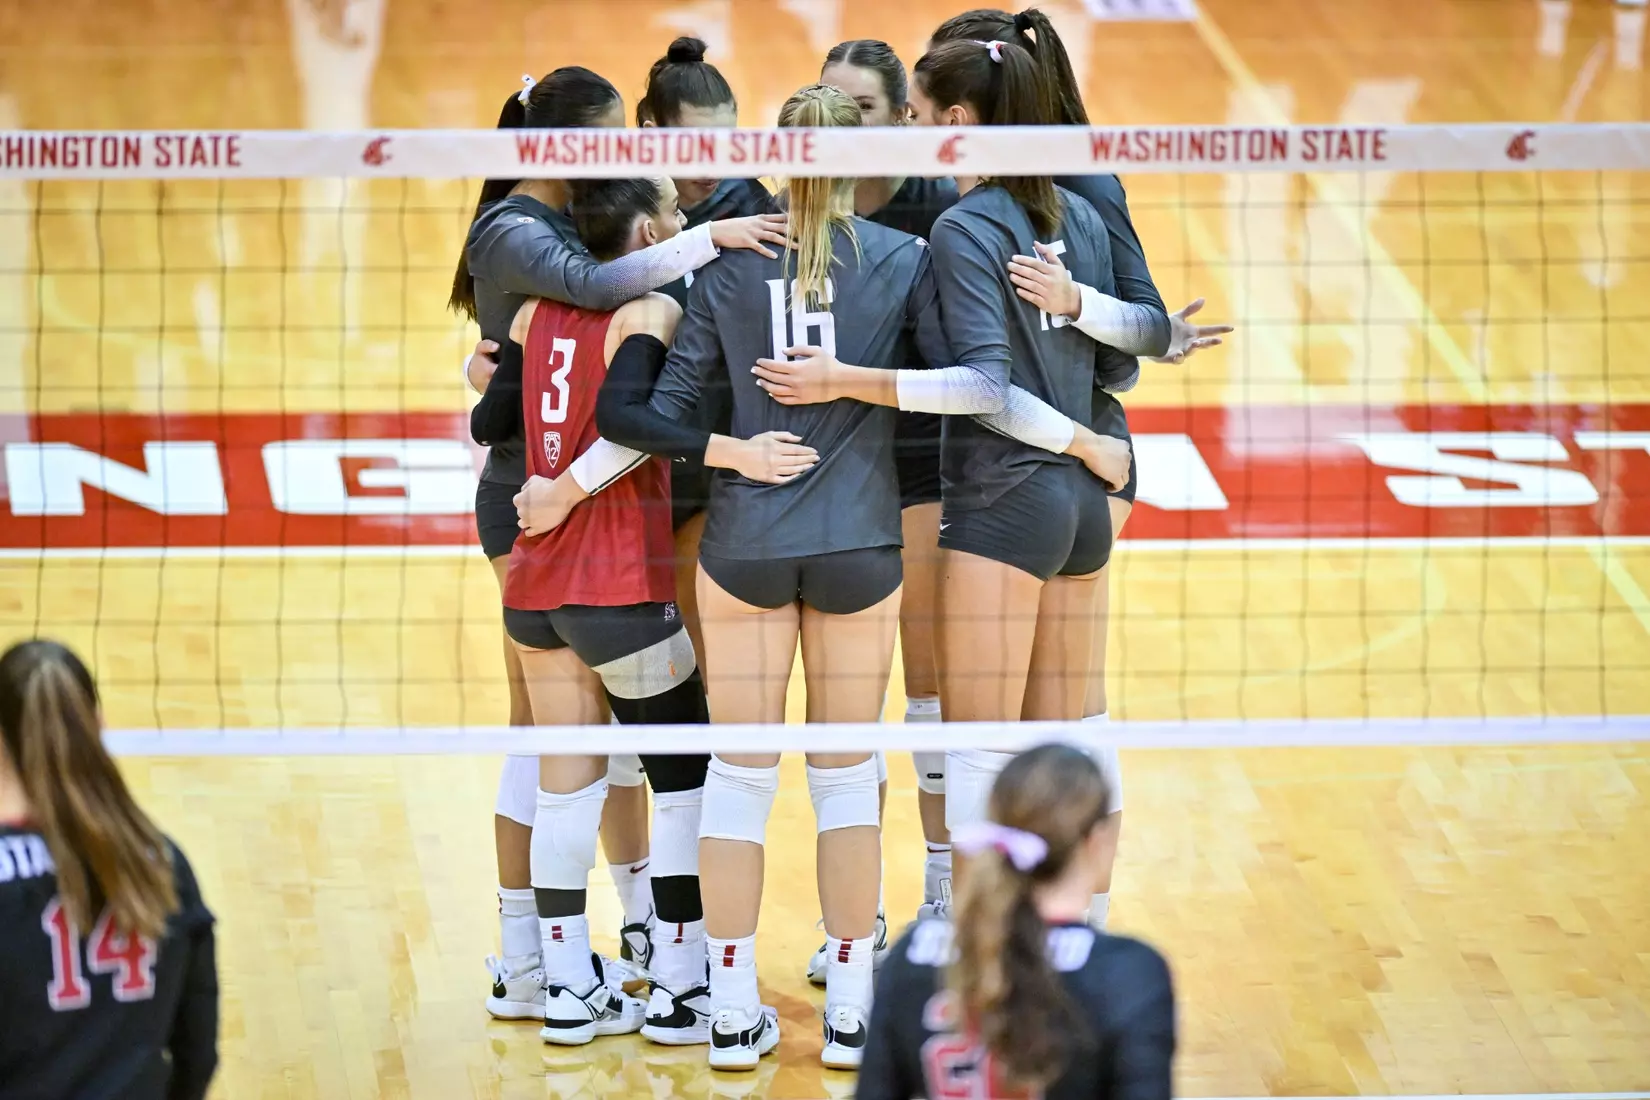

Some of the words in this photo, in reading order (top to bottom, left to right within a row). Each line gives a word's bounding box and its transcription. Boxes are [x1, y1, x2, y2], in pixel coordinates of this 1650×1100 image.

[0, 135, 141, 169] HINGTON
[154, 134, 242, 168] STATE
[515, 132, 716, 166] WASHINGTON
[729, 132, 817, 165] STATE
[1088, 130, 1288, 163] WASHINGTON
[1301, 128, 1388, 162] STATE
[765, 277, 836, 361] 16
[541, 337, 576, 423] 3
[41, 898, 157, 1011] 14
